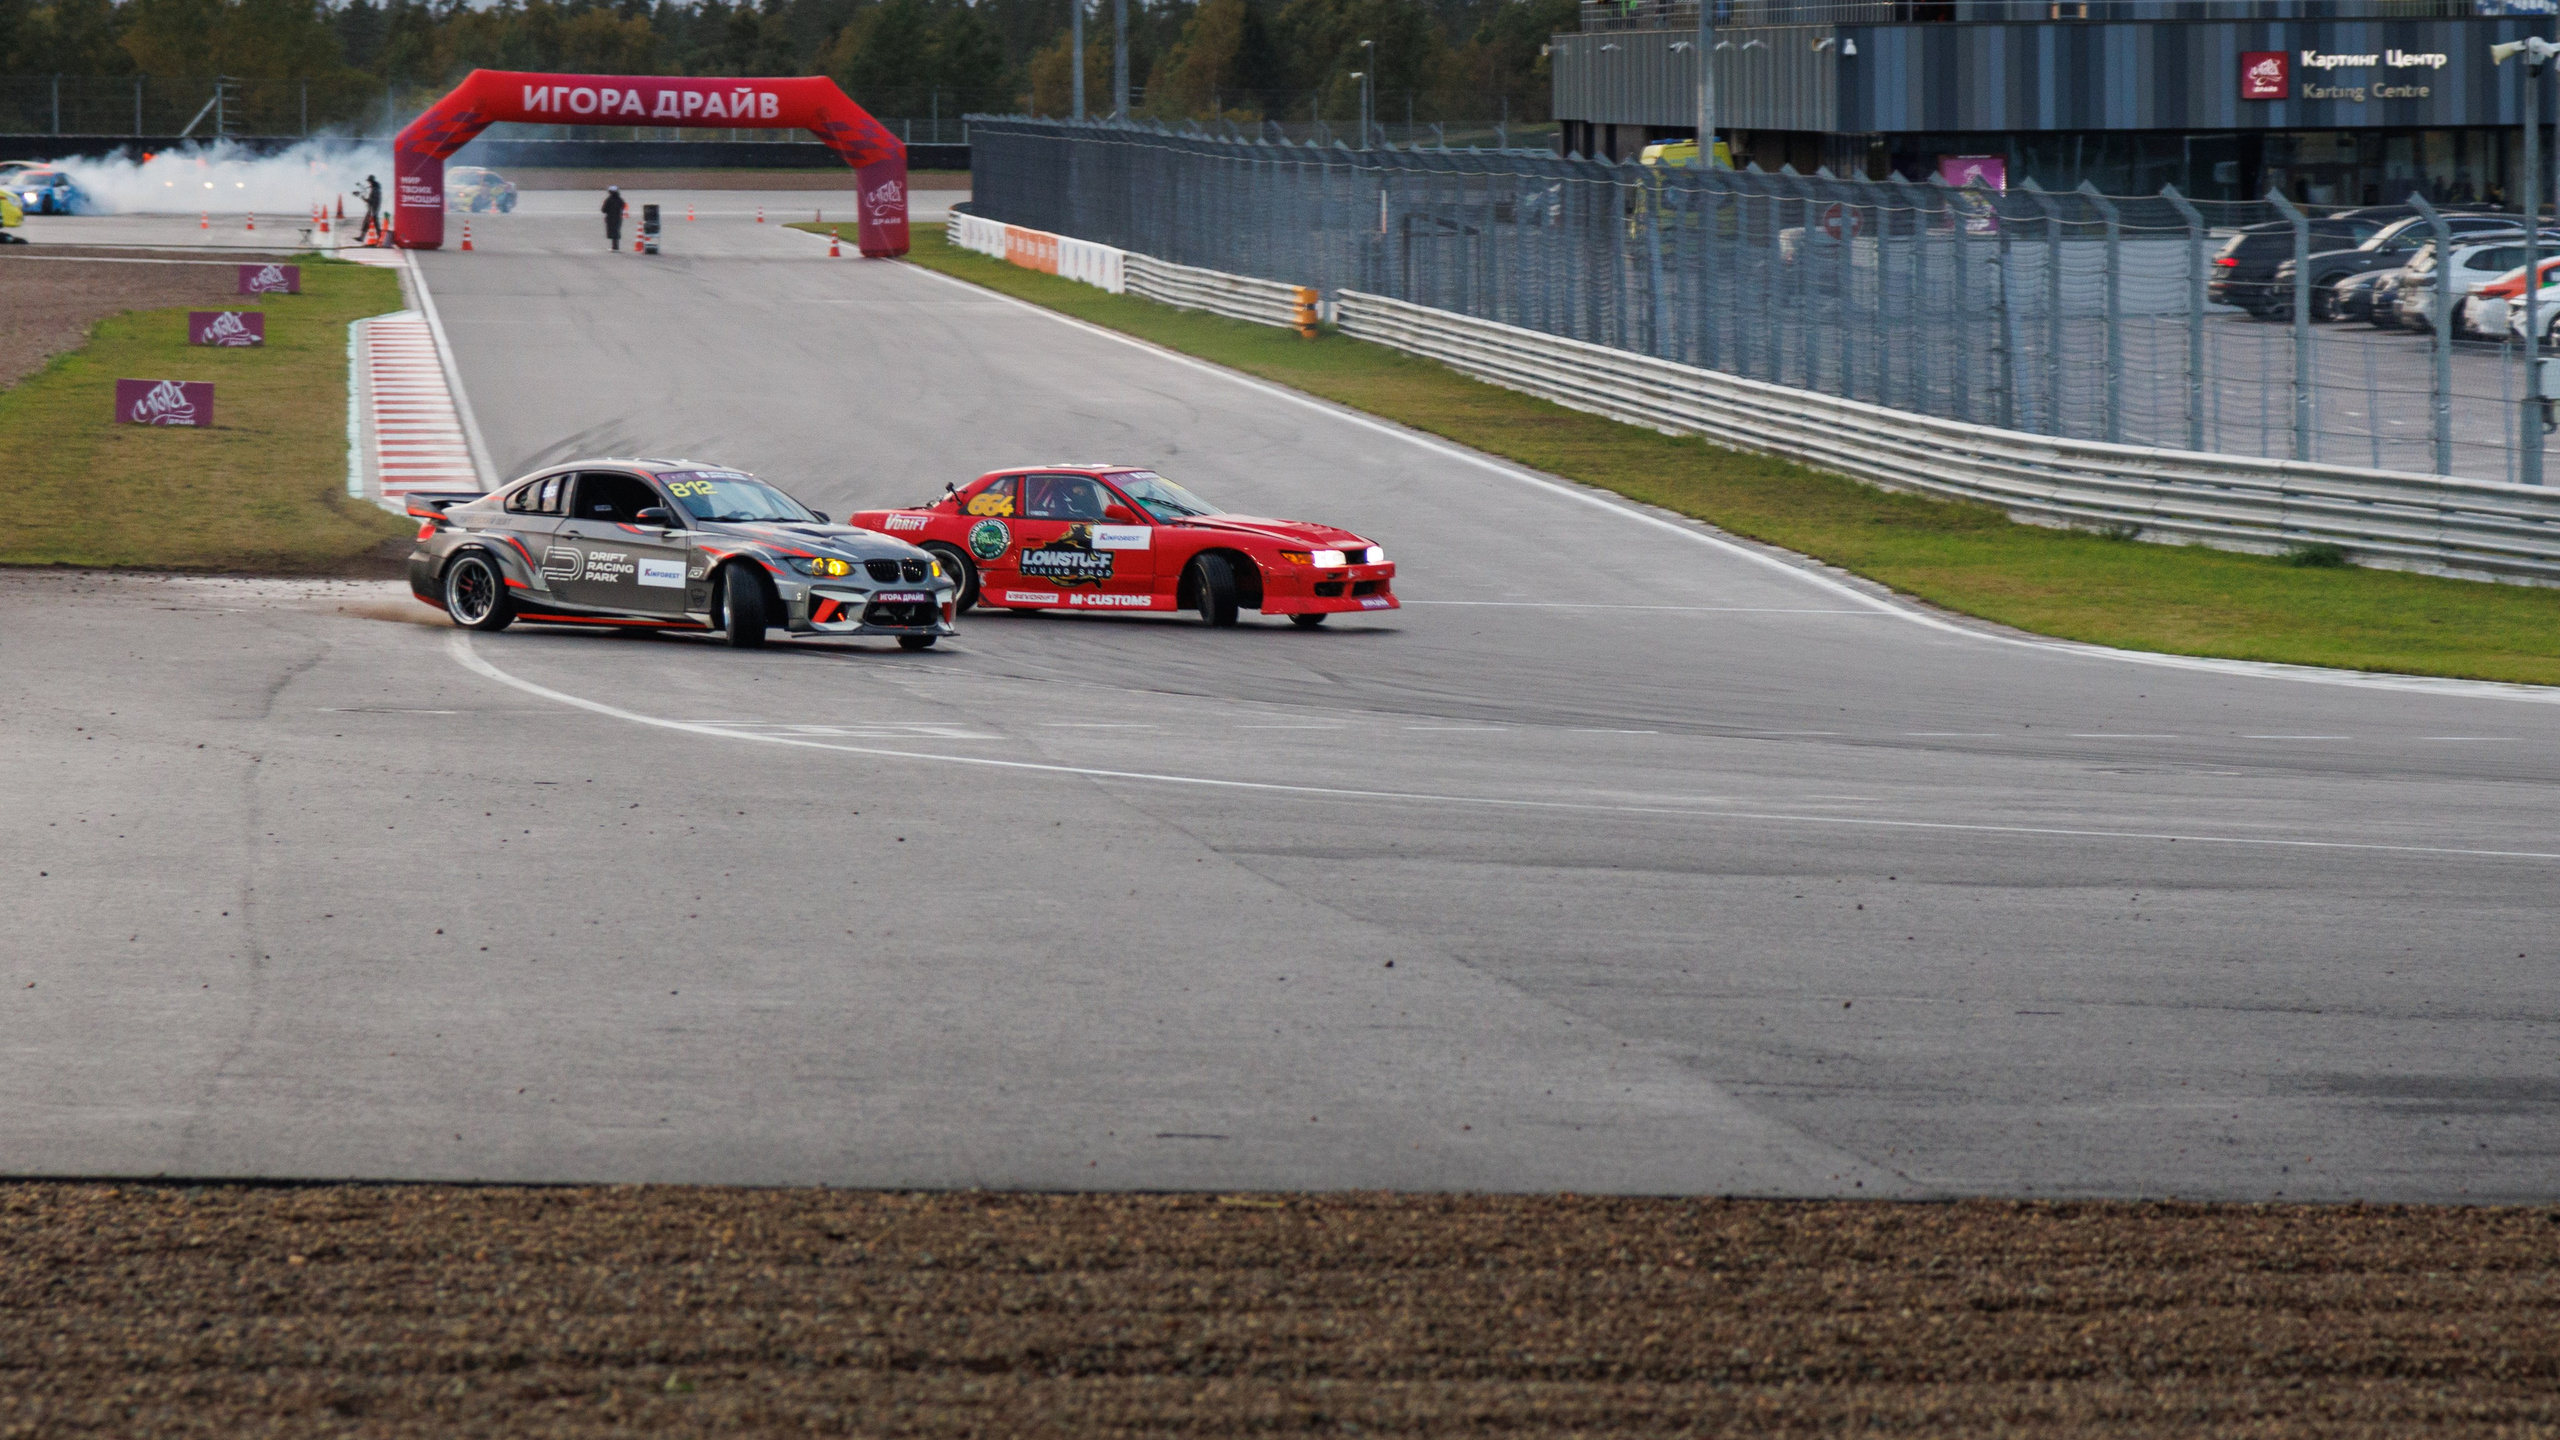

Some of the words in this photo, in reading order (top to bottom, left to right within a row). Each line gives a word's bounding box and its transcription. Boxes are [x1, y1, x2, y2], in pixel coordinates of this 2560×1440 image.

[2301, 50, 2380, 70] Картинг
[2386, 50, 2448, 70] Центр
[2302, 84, 2365, 102] Karting
[2373, 83, 2430, 98] Centre
[523, 85, 645, 116] ИГОРА
[652, 87, 779, 119] ДРАЙВ
[401, 176, 421, 184] МИР
[401, 194, 441, 204] ЭМОЦИЙ
[668, 480, 718, 497] 812
[967, 493, 1015, 517] 664
[589, 551, 627, 562] DRIFT
[586, 562, 634, 574] RACING
[644, 568, 680, 579] KINFOREST
[1021, 566, 1071, 576] TUNING
[1078, 567, 1112, 577] SHOP
[585, 571, 619, 583] PARK
[880, 593, 901, 601] ИГОРА
[903, 592, 924, 602] ДРАЙВ
